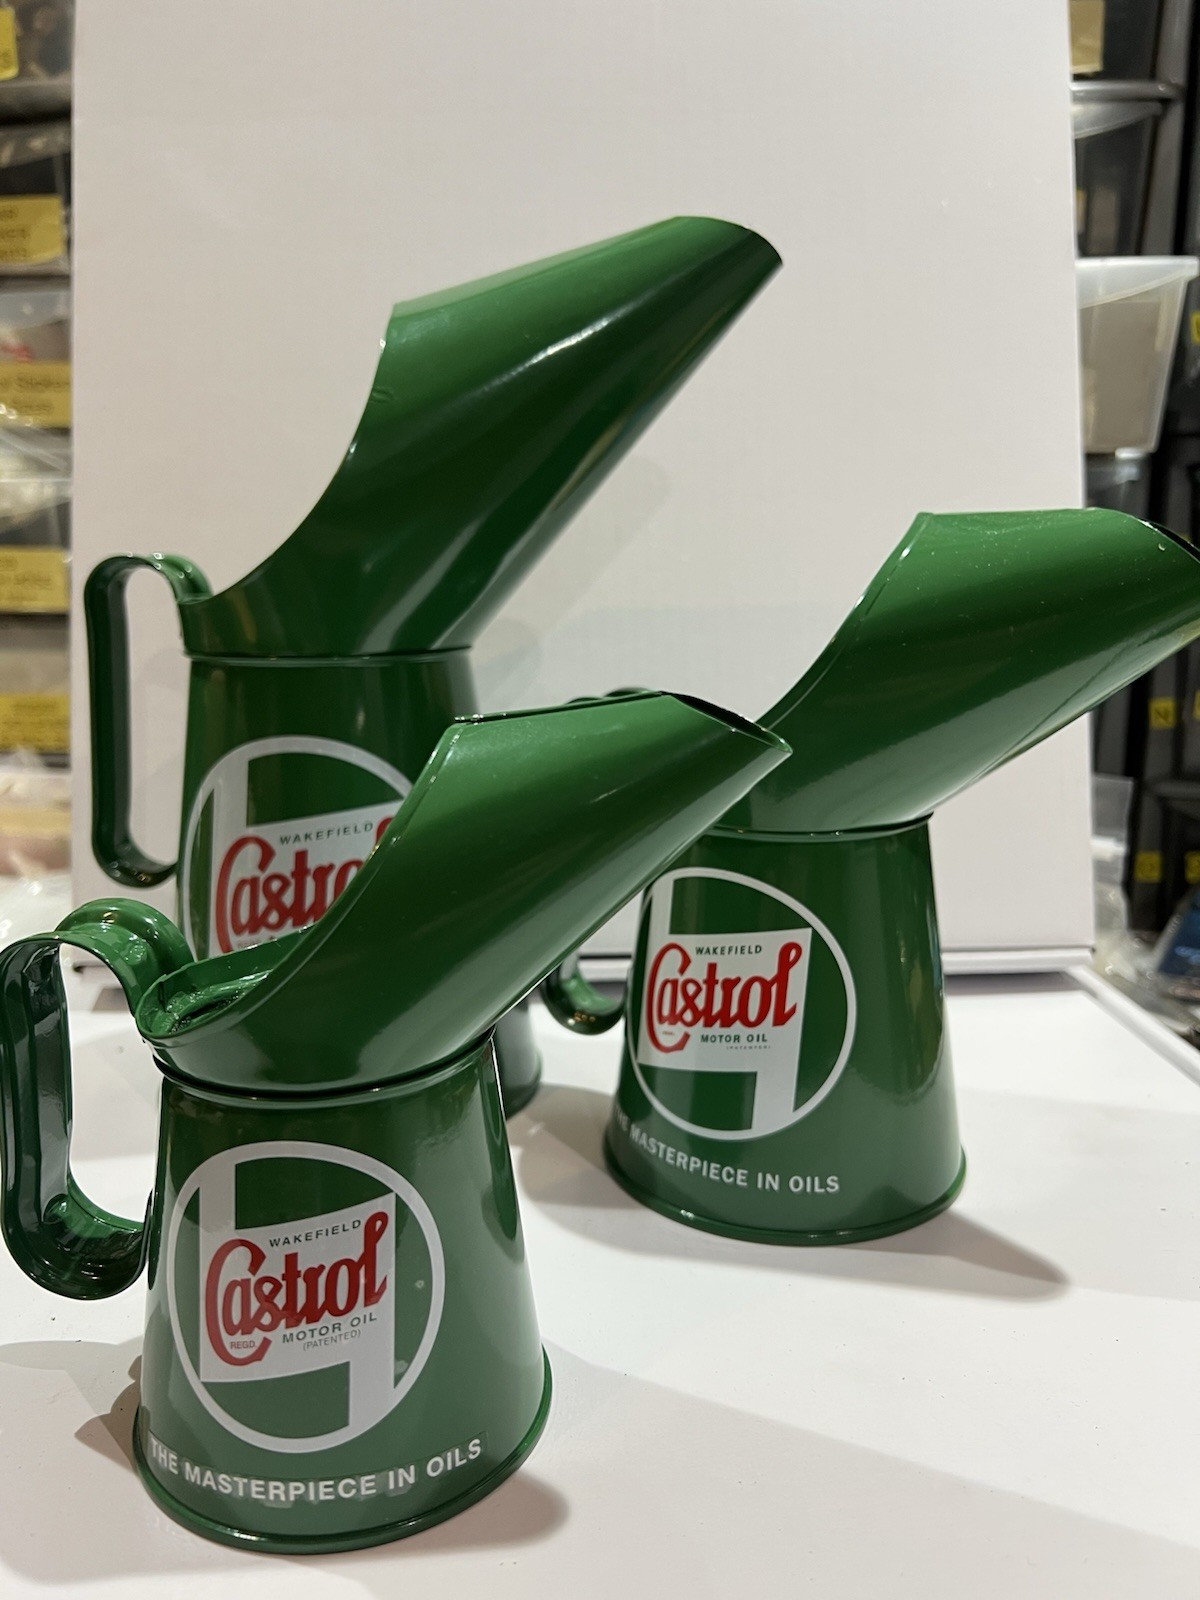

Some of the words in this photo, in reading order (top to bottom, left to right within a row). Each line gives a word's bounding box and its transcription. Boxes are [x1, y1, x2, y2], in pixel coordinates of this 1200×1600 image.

[280, 822, 374, 845] WAKEFIELD
[216, 817, 394, 953] Castr
[695, 944, 763, 956] WAKEFIELD
[646, 941, 803, 1054] Castrol
[701, 1034, 741, 1043] MOTOR
[747, 1033, 768, 1043] OIL
[629, 1124, 749, 1187] MASTERPIECE
[757, 1171, 780, 1192] IN
[788, 1174, 840, 1193] OILS
[269, 1219, 362, 1248] WAKEFIELD
[205, 1211, 389, 1367] Castrol
[282, 1322, 342, 1344] MOTOR
[350, 1312, 377, 1328] OIL
[302, 1329, 362, 1351] (PATENTED)
[150, 1437, 179, 1475] THE
[184, 1461, 377, 1502] MASTERPIECE
[387, 1464, 416, 1490] IN
[426, 1438, 482, 1477] OILS
